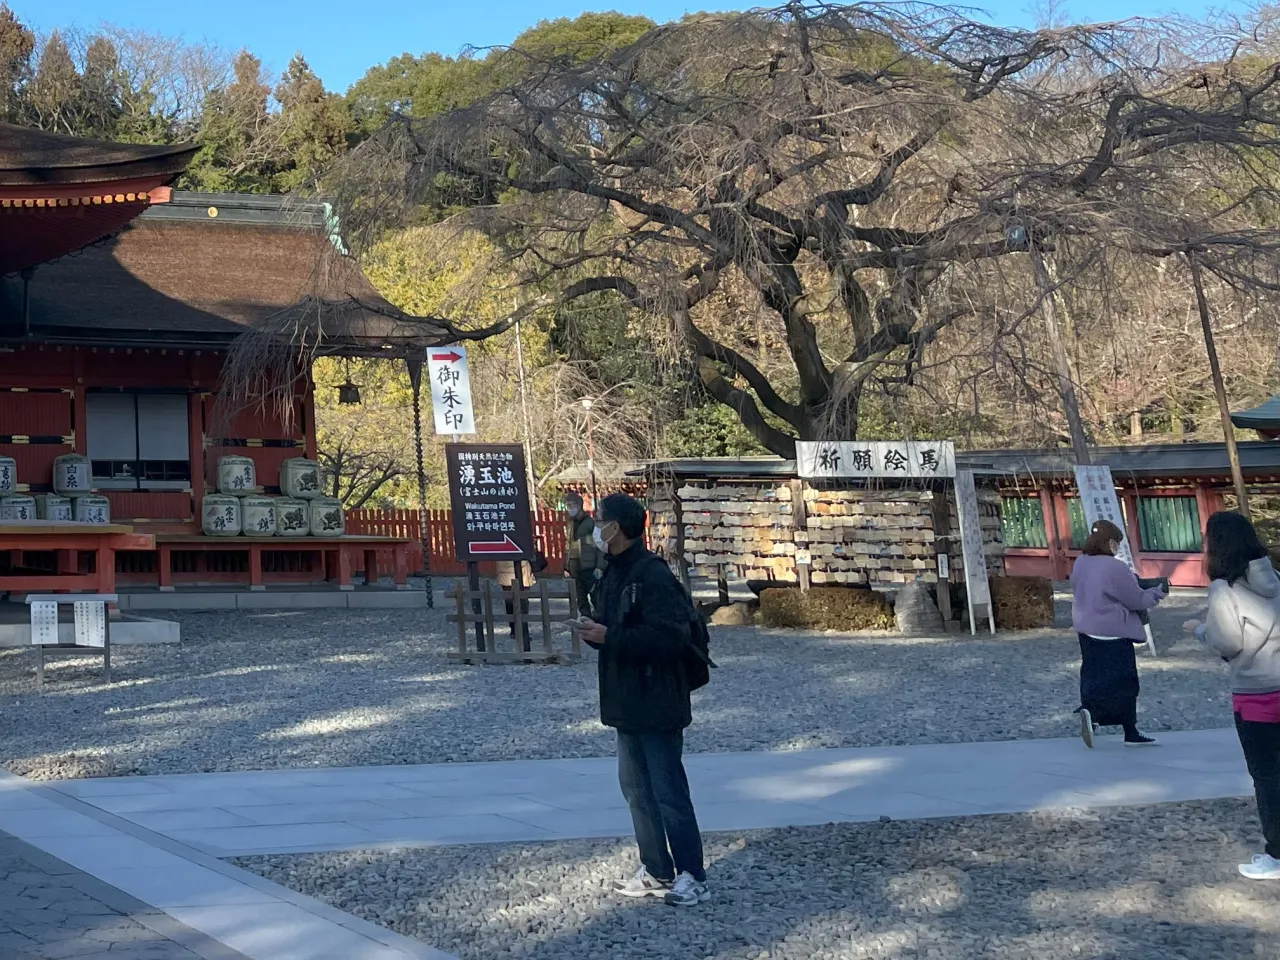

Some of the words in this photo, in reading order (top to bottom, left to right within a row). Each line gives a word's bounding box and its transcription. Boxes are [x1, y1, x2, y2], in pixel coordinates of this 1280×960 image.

[437, 365, 463, 430] 御朱印
[458, 452, 513, 461] 国特別天然記念物
[819, 448, 940, 472] 祈願絵馬
[66, 464, 78, 488] 白糸
[459, 465, 515, 485] 湧玉池
[464, 502, 498, 510] Wakutama
[498, 502, 516, 510] Pond
